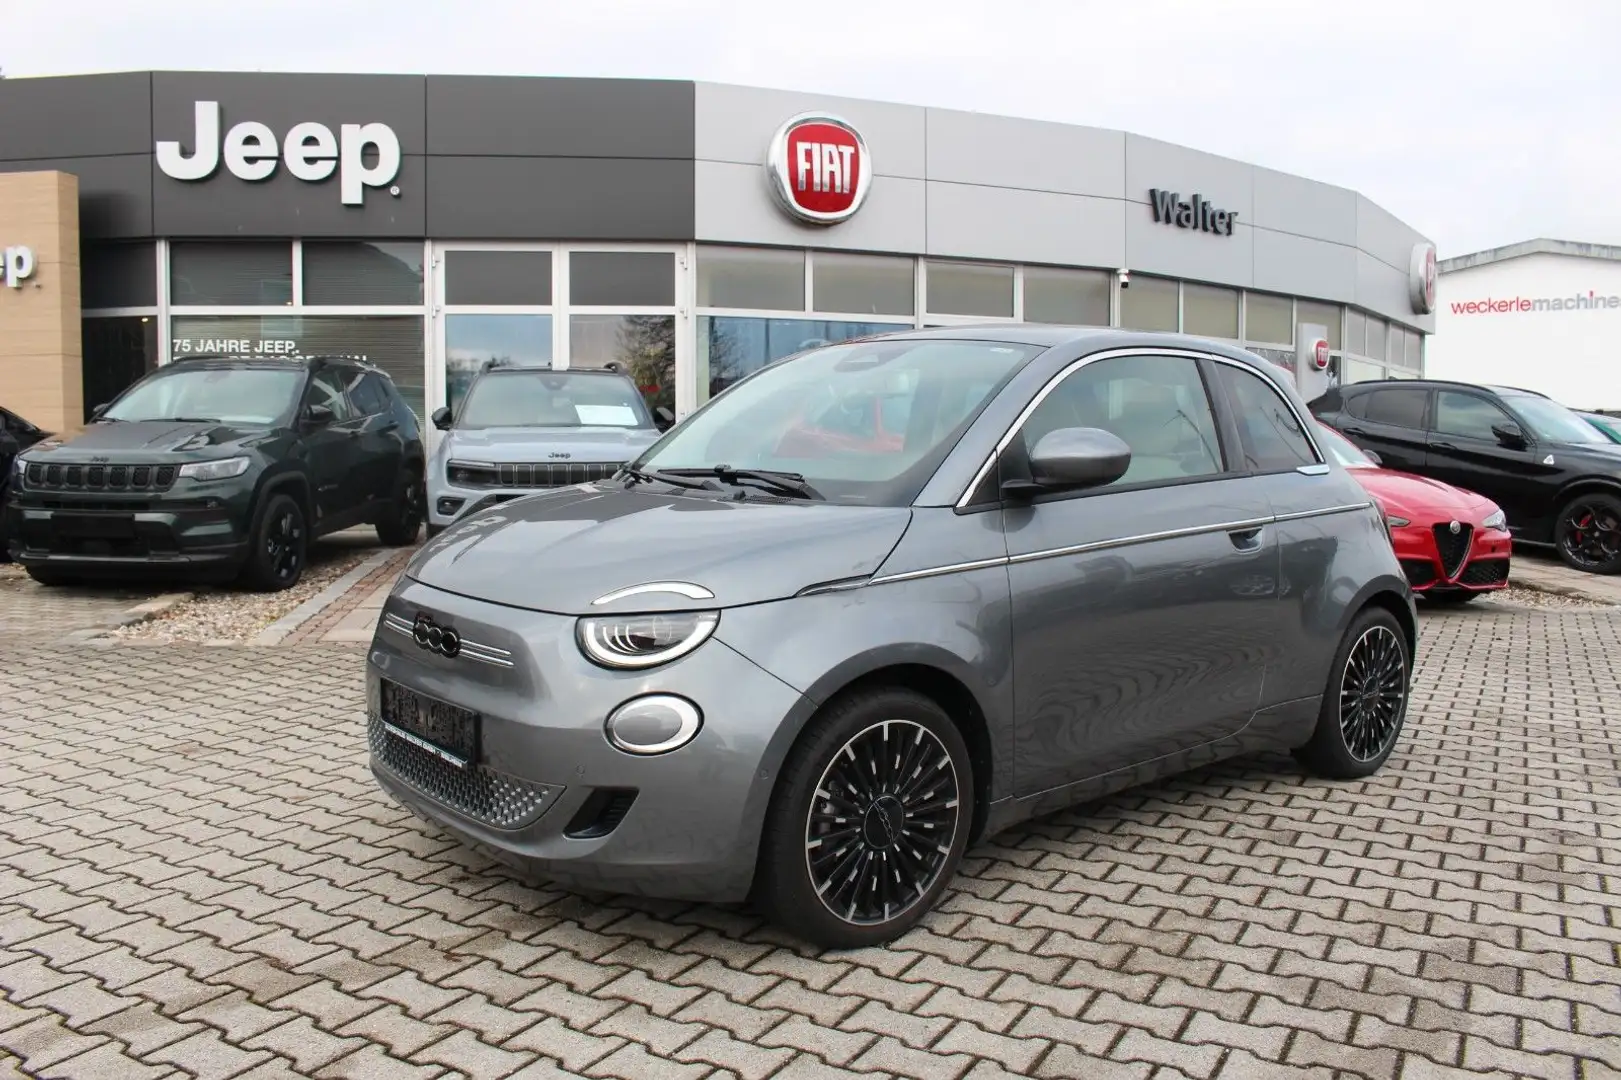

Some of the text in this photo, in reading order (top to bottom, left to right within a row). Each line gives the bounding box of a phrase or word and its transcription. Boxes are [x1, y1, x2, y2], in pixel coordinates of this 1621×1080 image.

[796, 141, 855, 194] FIAT
[1148, 188, 1239, 236] Walter
[1451, 290, 1621, 315] weckerlemachine
[173, 340, 191, 352] 75
[195, 340, 250, 353] JAHRE
